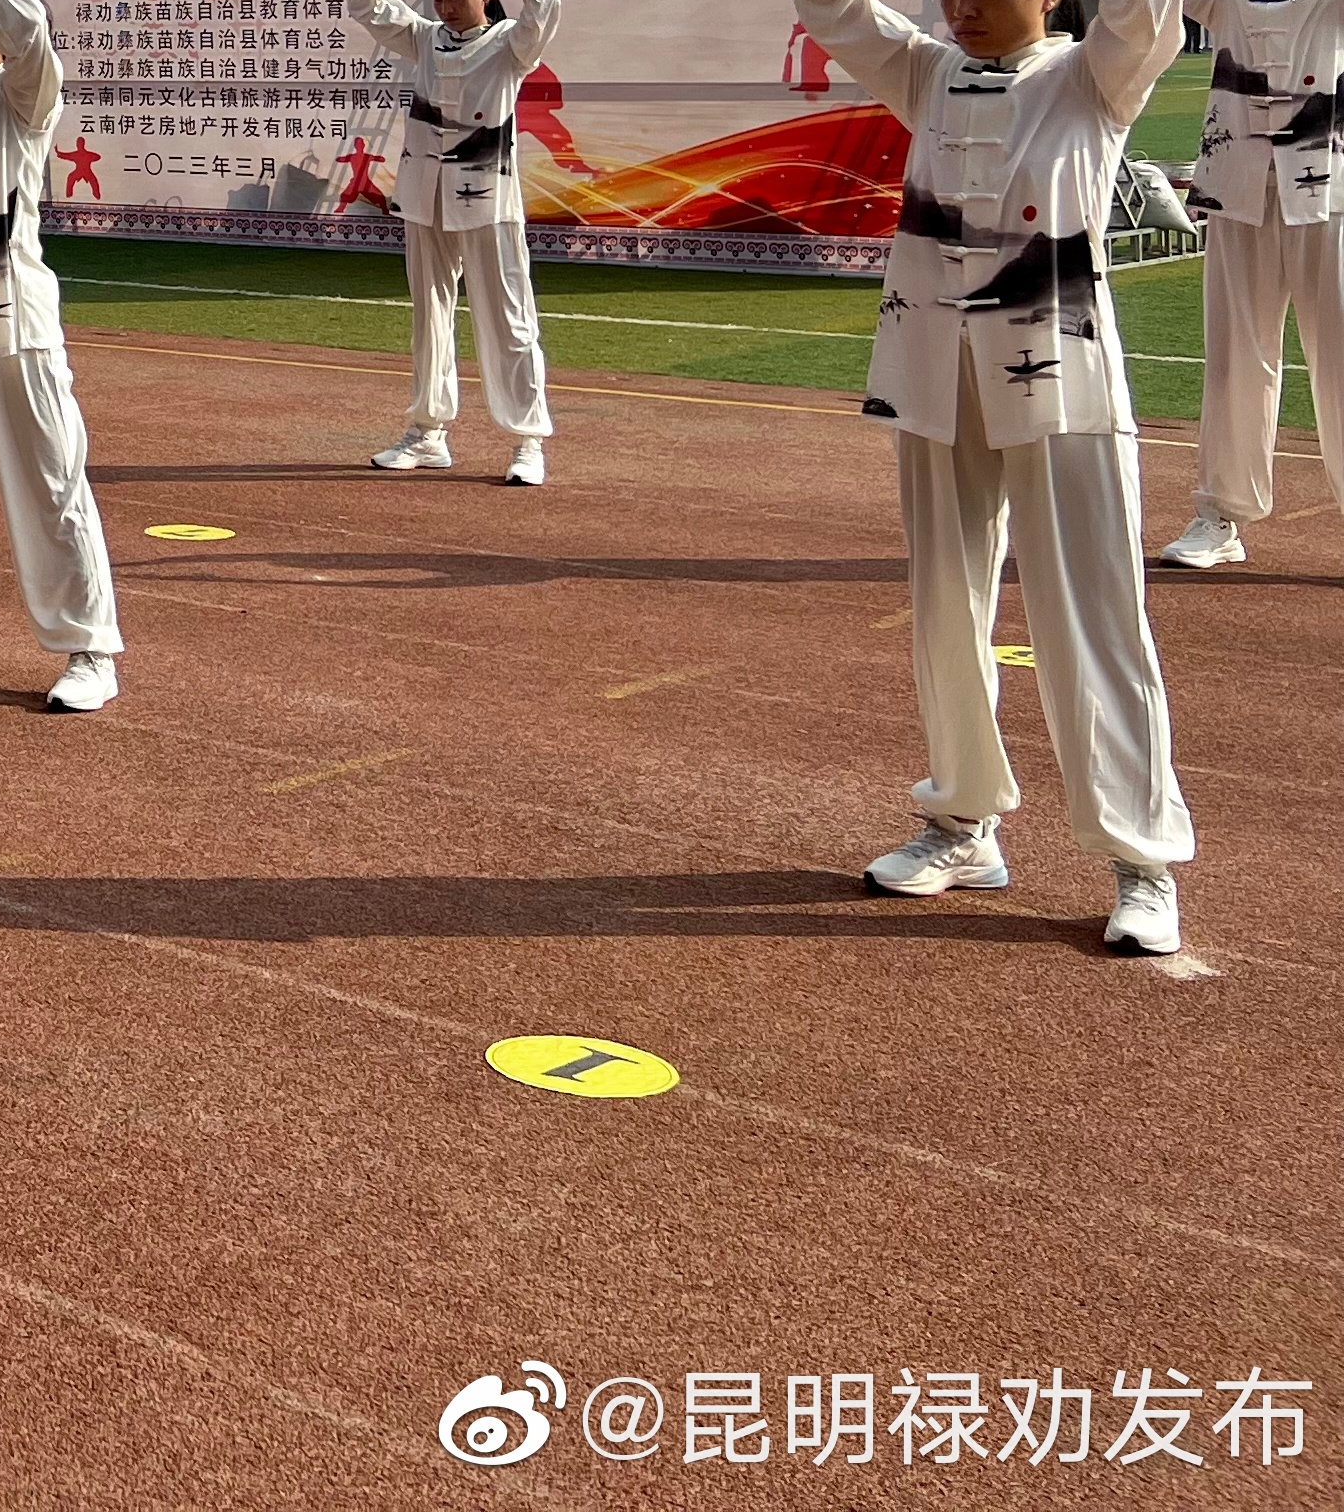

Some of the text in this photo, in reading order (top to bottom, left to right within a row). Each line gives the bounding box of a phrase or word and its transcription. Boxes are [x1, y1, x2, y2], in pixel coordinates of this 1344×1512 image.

[78, 57, 393, 80] 禄劝彝族苗族自治县健身气功协会
[79, 114, 347, 140] 云南伊艺房地产开发有限公司
[539, 1045, 641, 1083] 1
